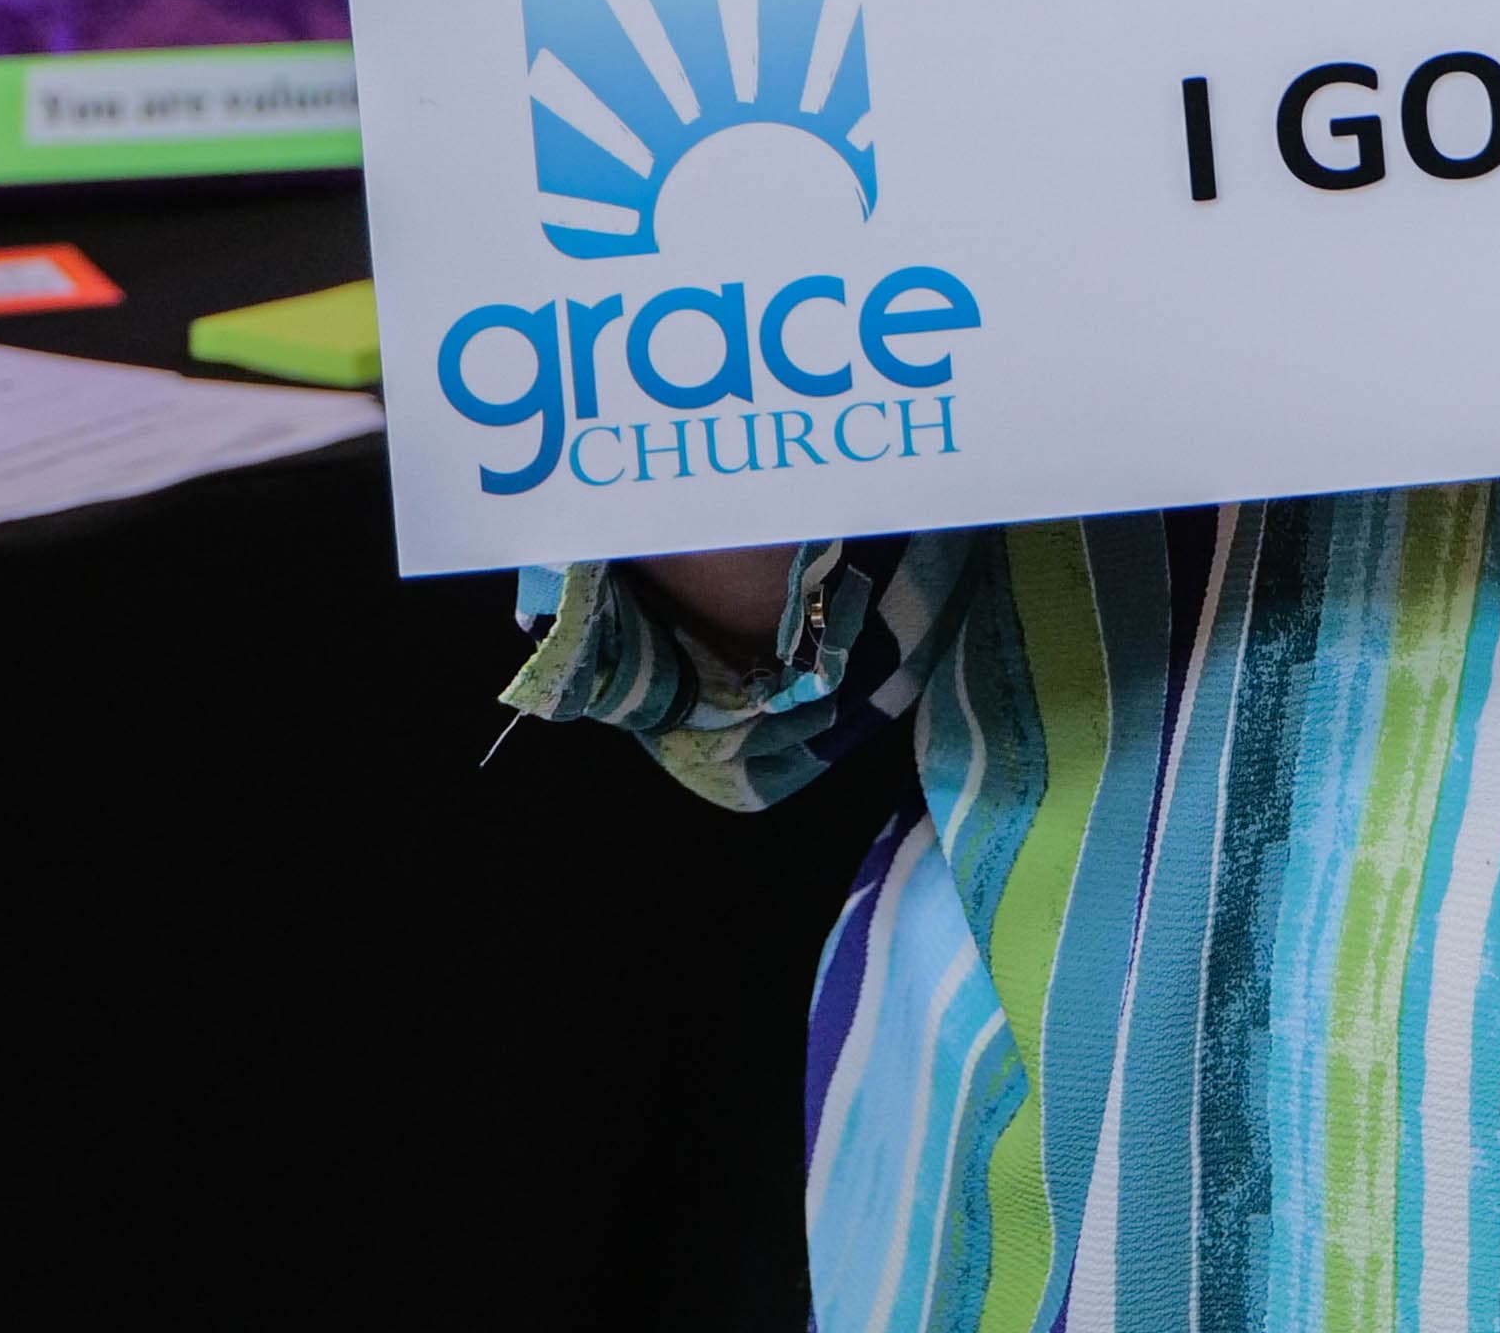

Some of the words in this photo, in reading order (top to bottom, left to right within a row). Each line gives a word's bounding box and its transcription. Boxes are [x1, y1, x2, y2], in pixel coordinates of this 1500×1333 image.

[1182, 77, 1218, 202] I
[437, 266, 982, 496] grace
[568, 395, 962, 488] CHURCH
